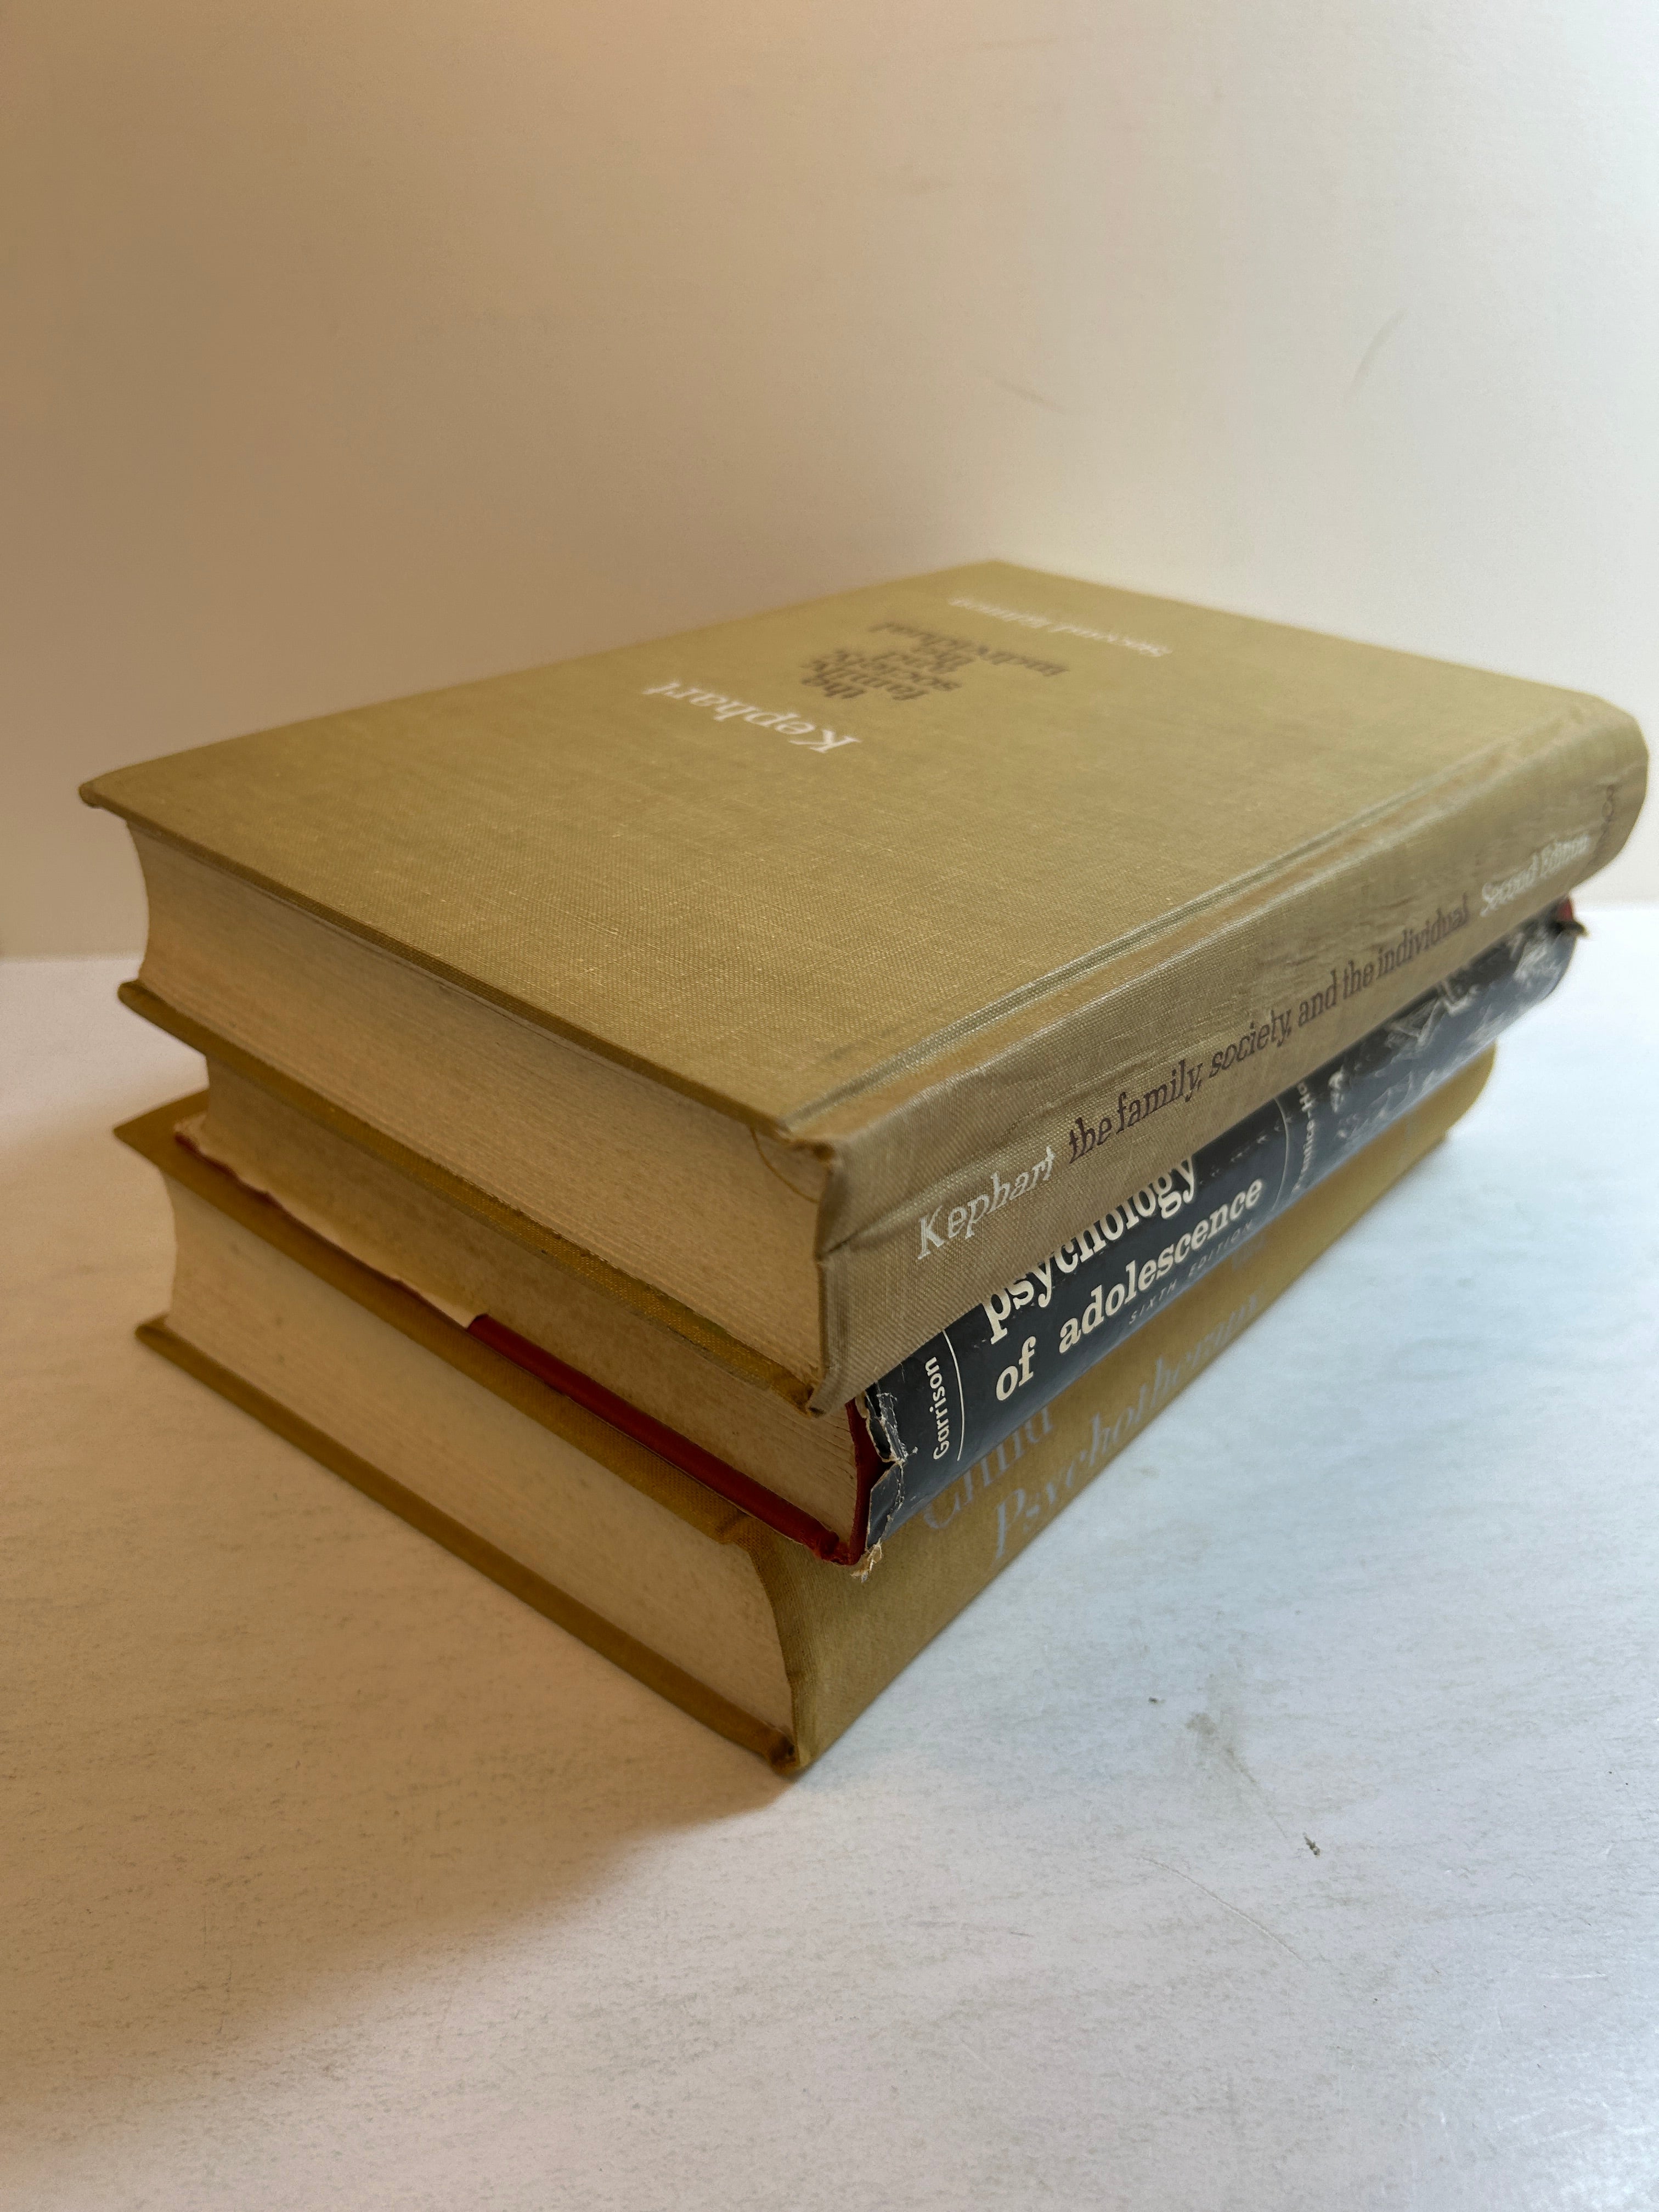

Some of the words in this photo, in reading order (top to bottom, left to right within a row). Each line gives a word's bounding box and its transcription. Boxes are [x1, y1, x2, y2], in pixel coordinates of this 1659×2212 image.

[643, 678, 861, 754] Kephart
[917, 1146, 1056, 1260] Kephart
[1068, 1117, 1112, 1164] the
[1116, 1059, 1203, 1134] family,
[1208, 1008, 1291, 1079] society,
[1297, 969, 1339, 1028] and
[1342, 960, 1375, 1000] the
[1377, 891, 1471, 978] individual
[995, 1335, 1037, 1402] of
[1058, 1177, 1263, 1354] adolescence
[1128, 1278, 1177, 1325] SIXTH
[1188, 1218, 1253, 1278] EDITION
[924, 1357, 951, 1461] Garrison
